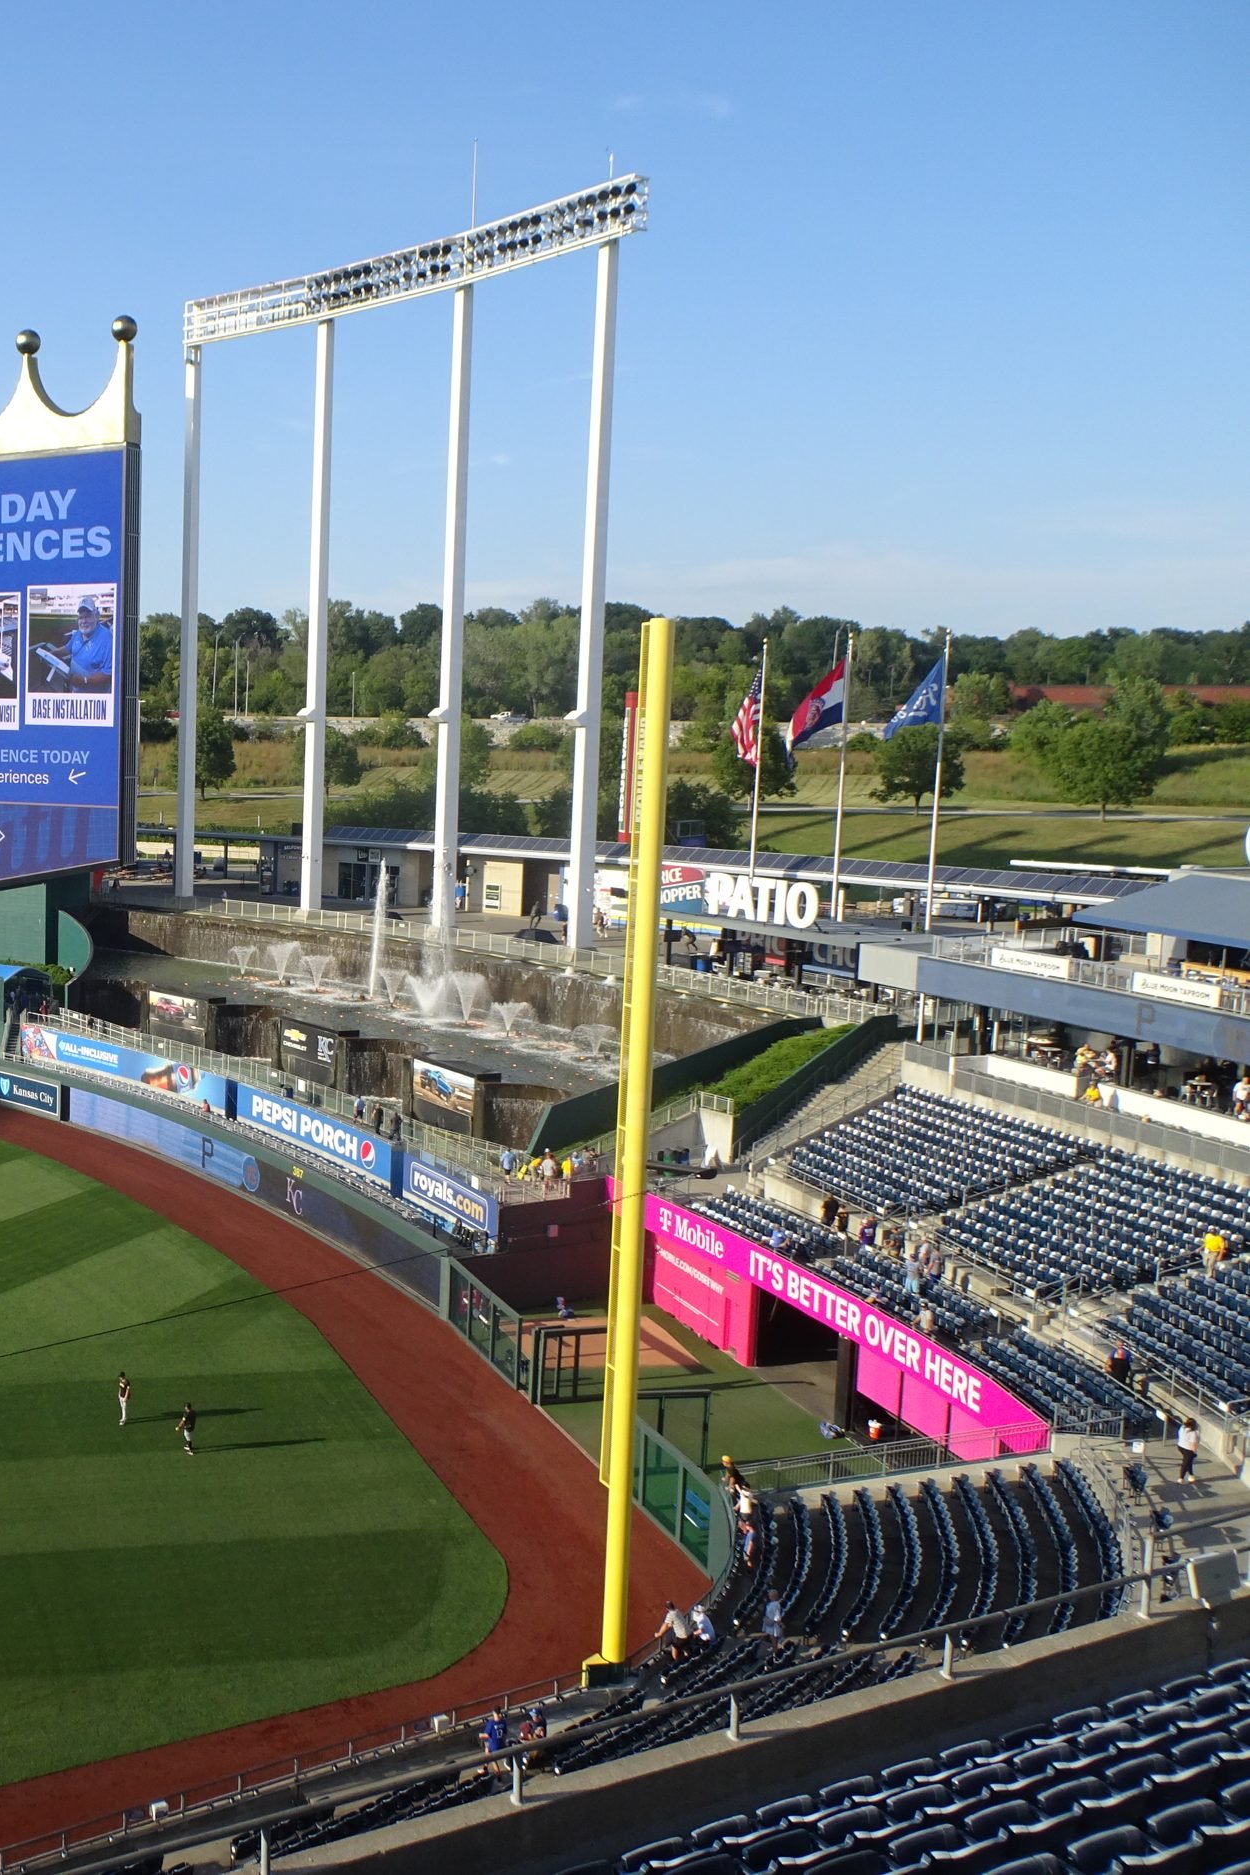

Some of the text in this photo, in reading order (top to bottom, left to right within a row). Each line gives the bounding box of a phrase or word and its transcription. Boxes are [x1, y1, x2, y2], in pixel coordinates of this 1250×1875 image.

[1, 489, 76, 524] DAY
[0, 705, 16, 722] VISIT
[32, 699, 106, 720] BASE INSTALLATION
[42, 750, 90, 764] TODAY
[708, 872, 820, 929] PATIO
[1160, 984, 1178, 992] MOON
[1180, 988, 1210, 998] TAPROOM
[65, 1044, 119, 1064] ALL-INCLUSIVE
[12, 1084, 54, 1107] Kansas City
[252, 1095, 358, 1160] PEPSI PORCH
[202, 1137, 214, 1168] P
[286, 1177, 302, 1215] KC
[413, 1170, 484, 1222] royals.com
[674, 1214, 724, 1259] Mobile
[750, 1250, 982, 1413] IT'S BETTER OVER HERE
